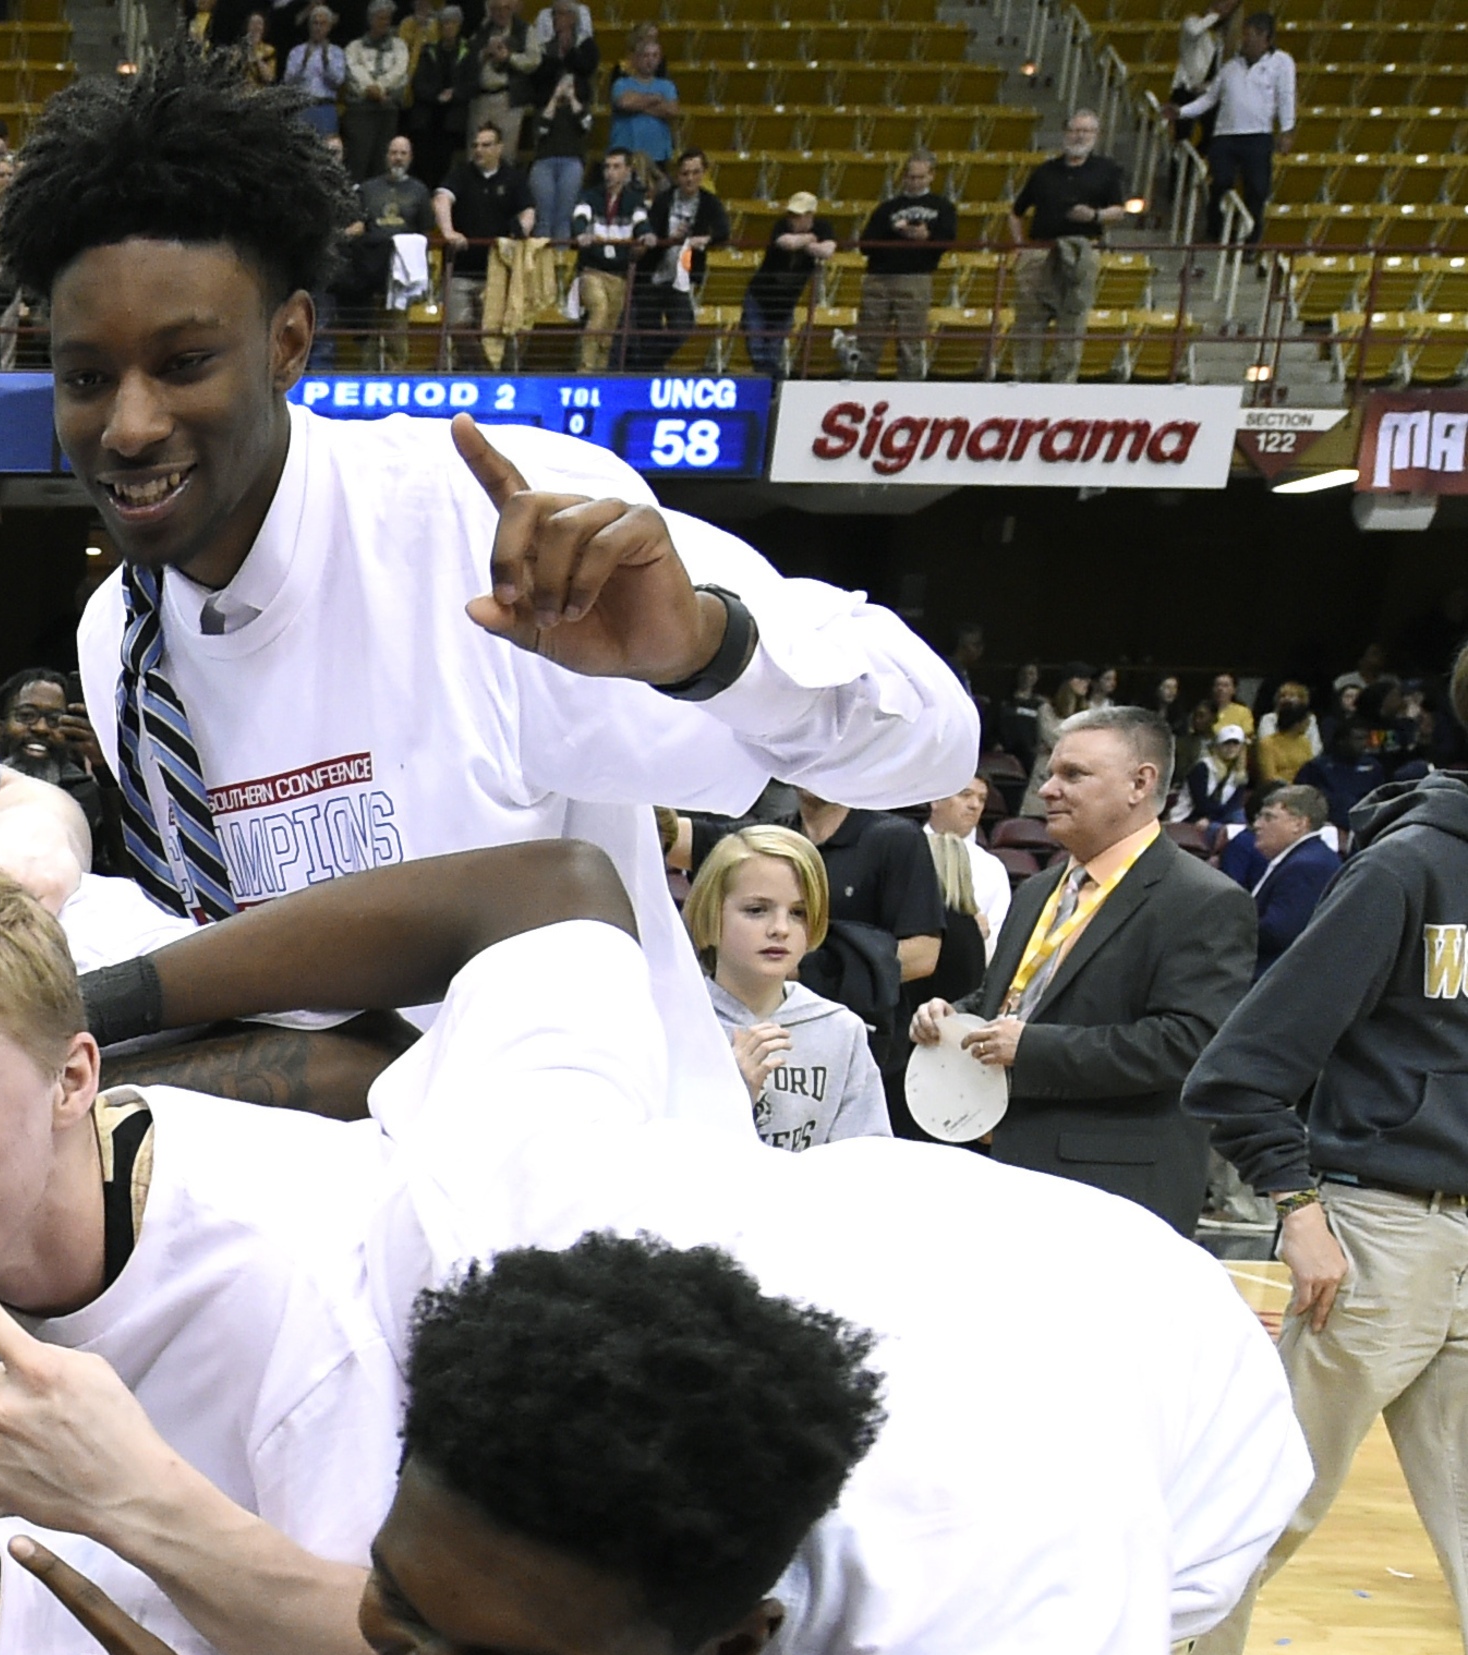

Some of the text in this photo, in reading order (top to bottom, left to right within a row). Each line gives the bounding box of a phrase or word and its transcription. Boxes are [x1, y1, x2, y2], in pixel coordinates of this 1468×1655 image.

[304, 382, 517, 410] PERIOD 2
[651, 379, 738, 409] UNCG
[569, 413, 585, 434] 0
[1245, 412, 1314, 428] SECTION
[652, 418, 721, 467] 58
[812, 401, 1201, 476] Signarama
[1256, 432, 1296, 453] 122
